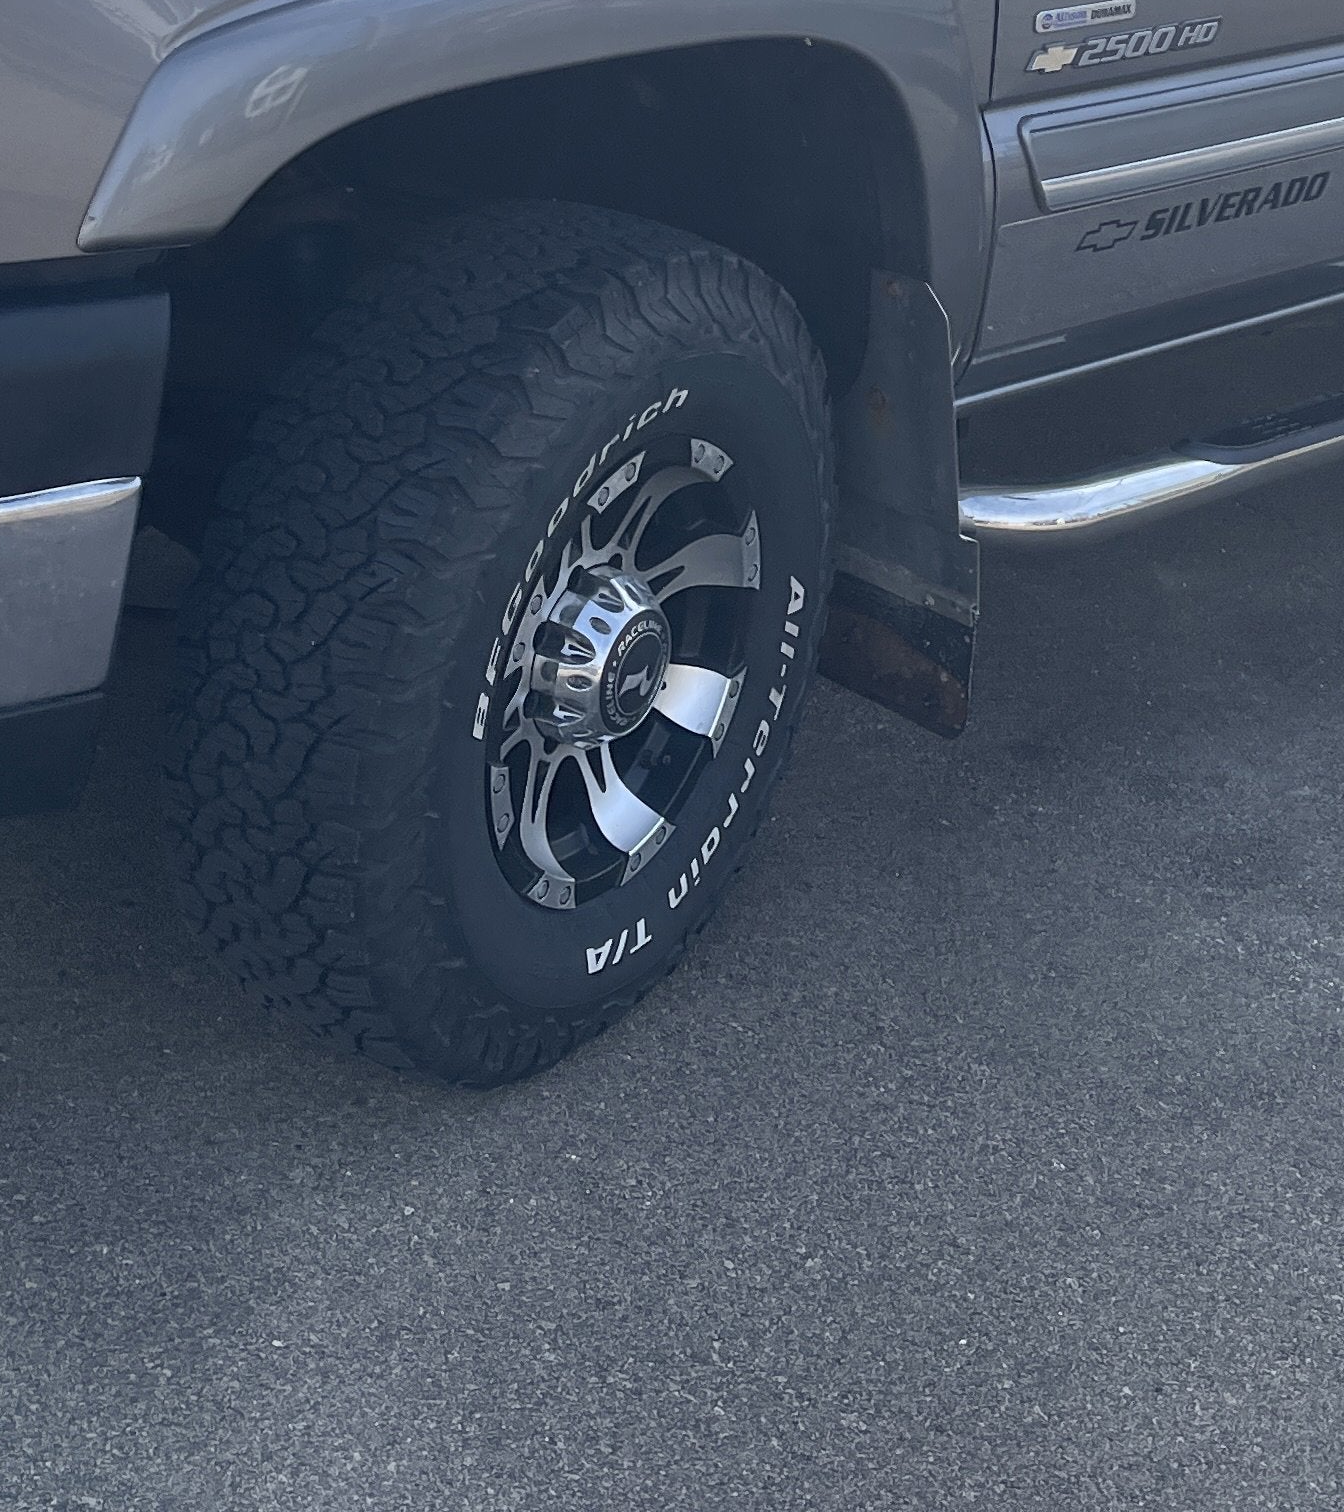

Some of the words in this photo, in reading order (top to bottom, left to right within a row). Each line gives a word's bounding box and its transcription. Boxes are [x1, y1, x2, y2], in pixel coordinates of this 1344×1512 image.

[1077, 25, 1176, 67] 2500
[1177, 20, 1221, 48] HD
[1140, 171, 1331, 241] SILVERADO
[471, 388, 690, 741] BFGoodrich
[667, 575, 805, 910] All-Terrain
[585, 917, 653, 975] T/A
